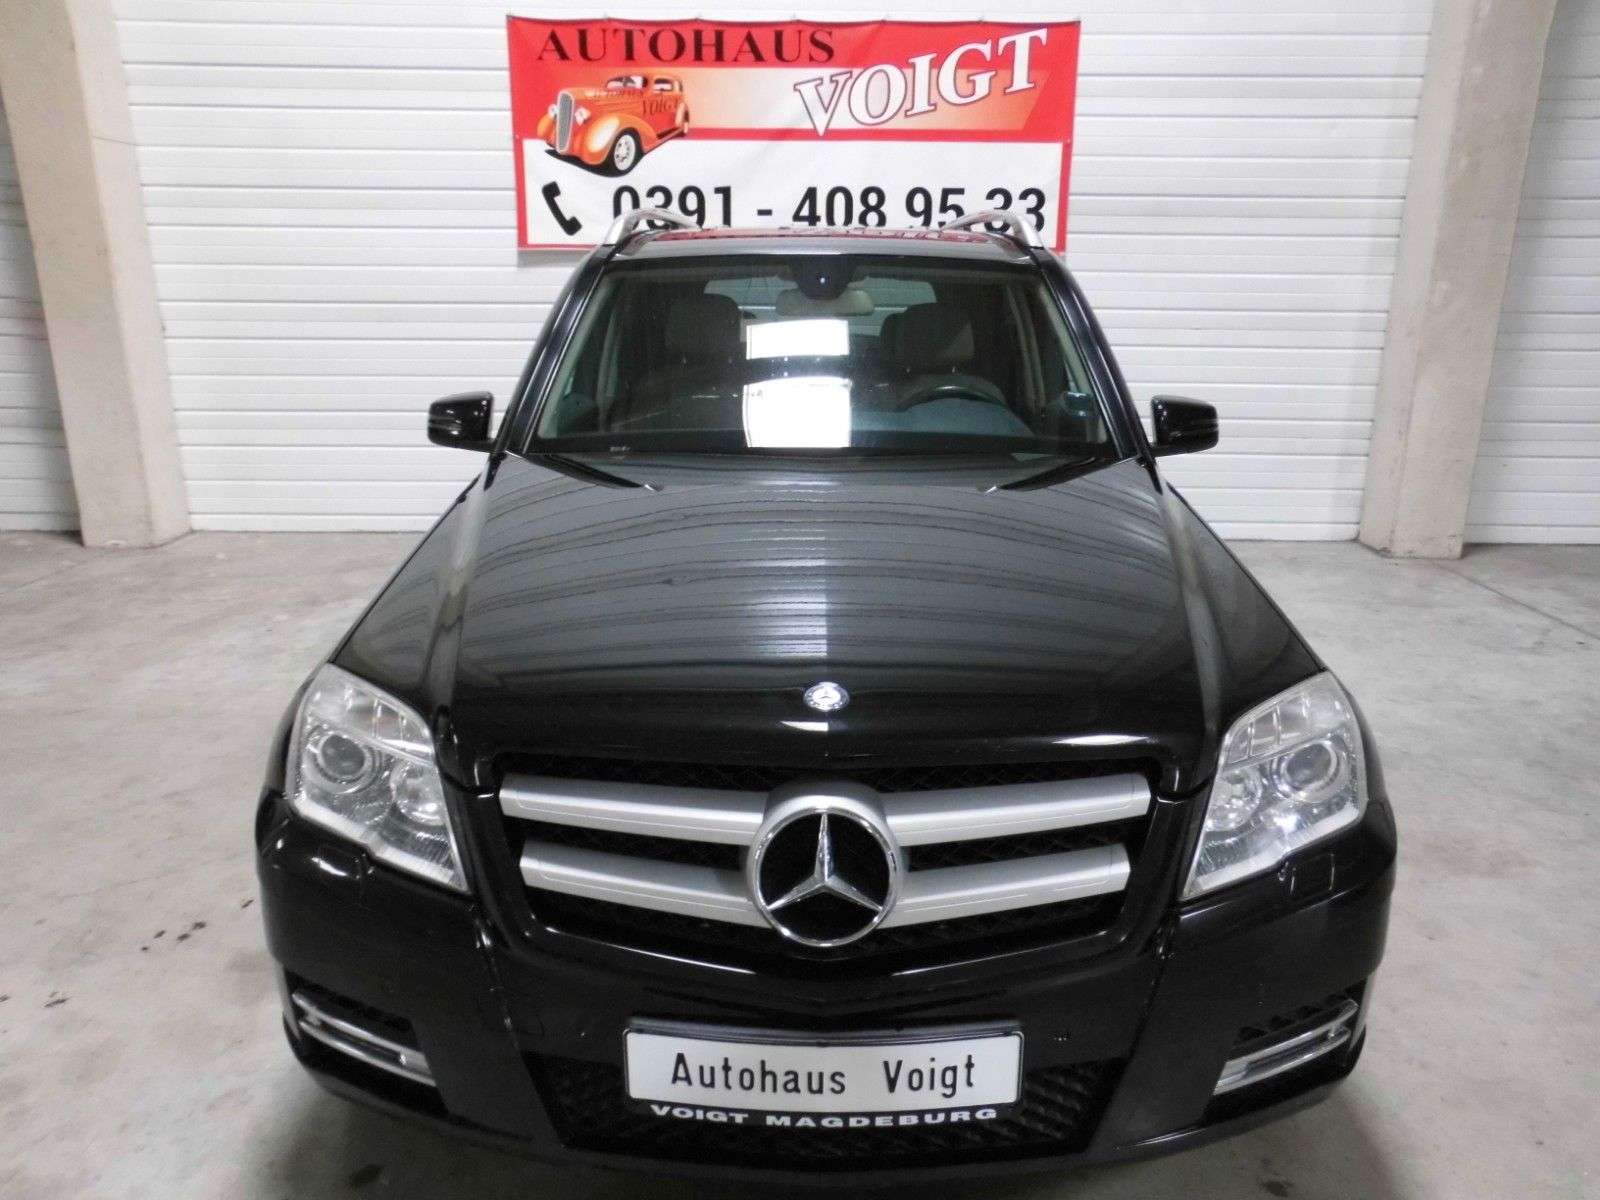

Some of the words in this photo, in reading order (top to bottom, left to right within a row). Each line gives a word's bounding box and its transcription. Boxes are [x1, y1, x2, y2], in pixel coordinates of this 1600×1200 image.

[537, 28, 836, 63] AUTOHAUS
[794, 27, 1049, 137] VOIGT
[613, 185, 732, 231] 0391
[792, 186, 887, 228] 408
[905, 187, 965, 229] 95
[985, 187, 1046, 233] 33
[671, 1052, 846, 1096] Autohaus
[883, 1054, 976, 1099] Voigt
[651, 1103, 749, 1125] VOIGT
[765, 1107, 998, 1129] MAGDEBURG
